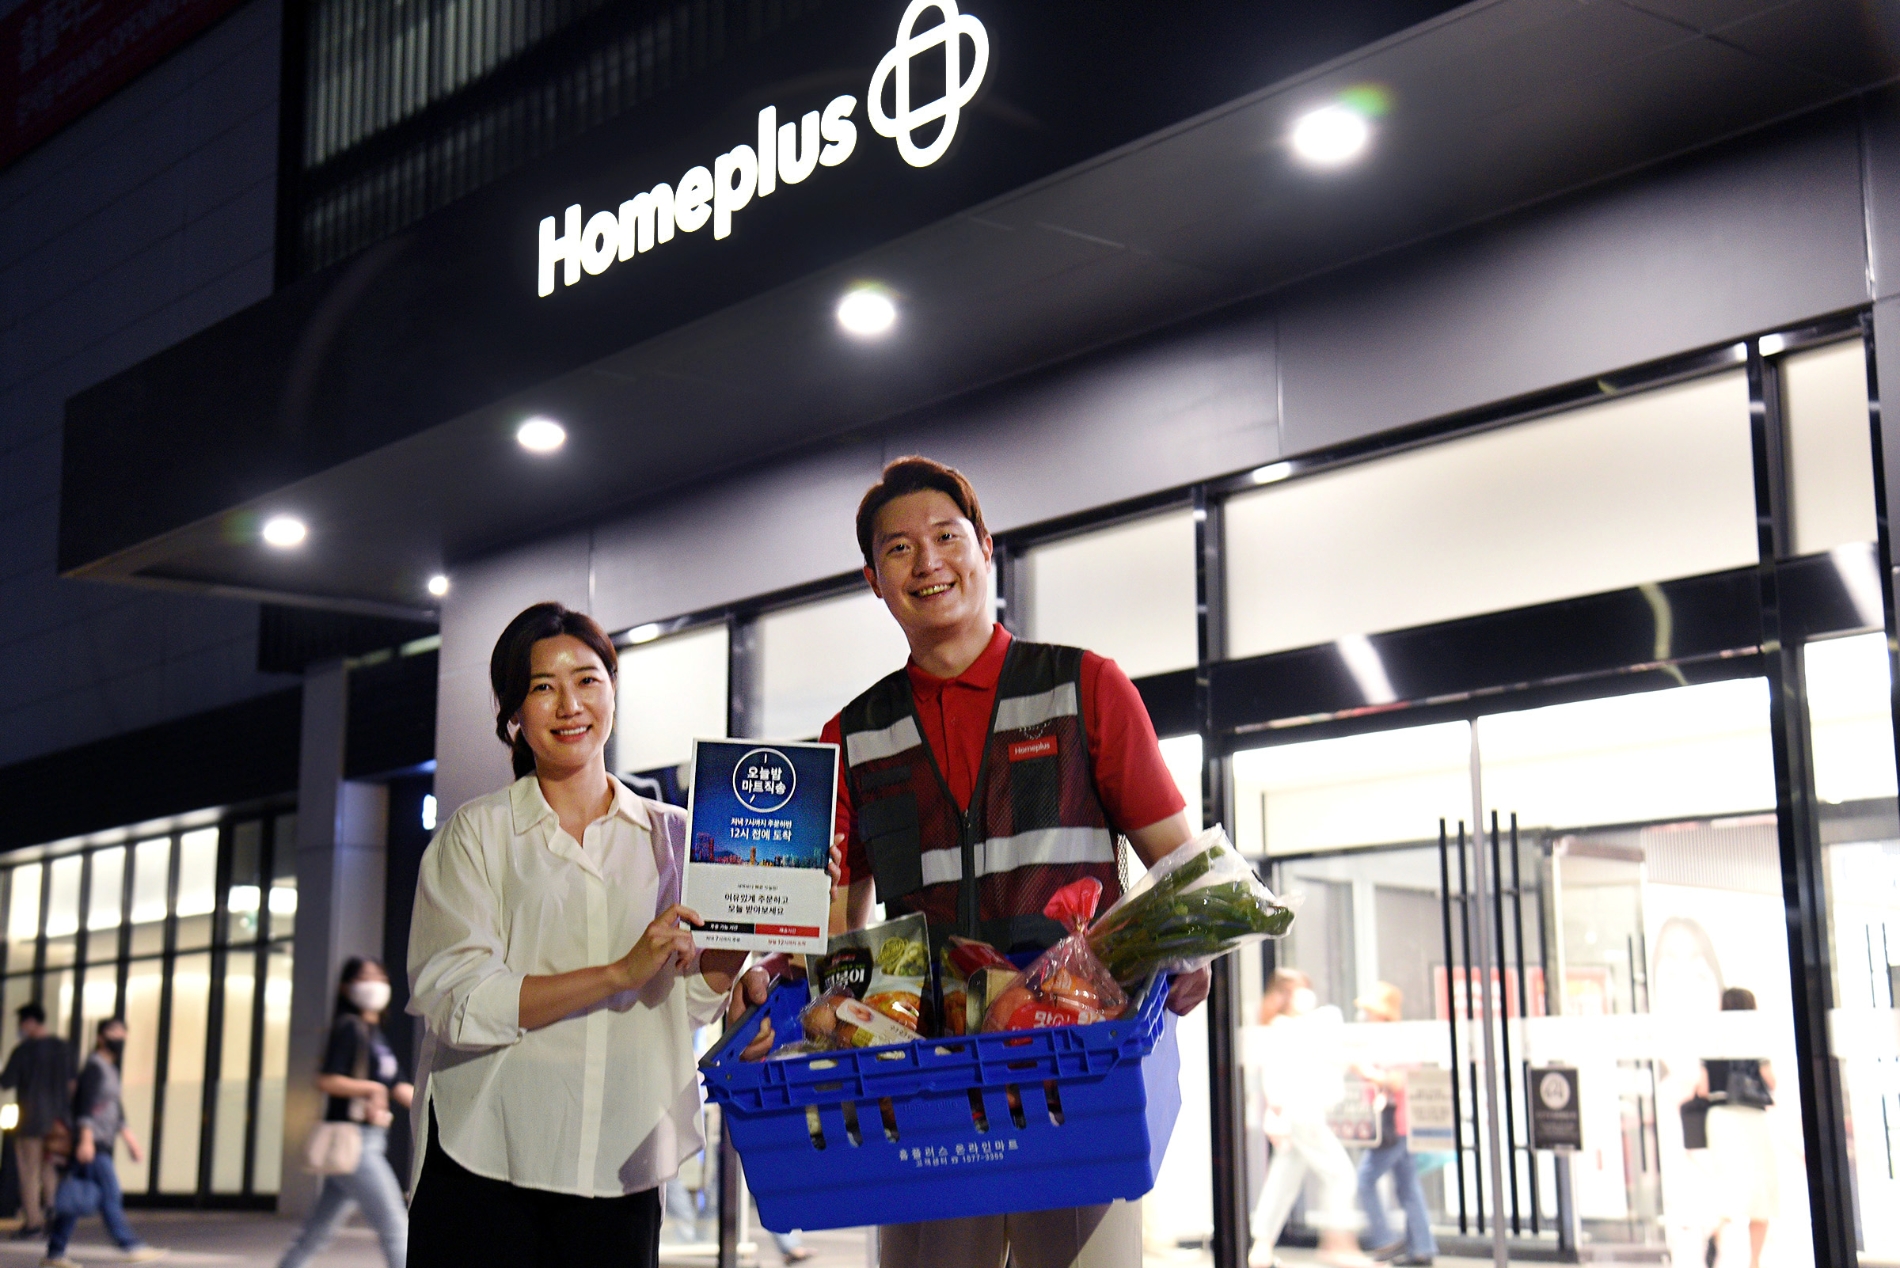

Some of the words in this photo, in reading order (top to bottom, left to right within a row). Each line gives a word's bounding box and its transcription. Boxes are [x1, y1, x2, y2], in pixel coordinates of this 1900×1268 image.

[538, 95, 857, 298] Homeplus
[1014, 742, 1050, 755] Homeplus
[747, 766, 783, 781] 오늘밤
[741, 780, 787, 795] 마트직송
[730, 817, 744, 827] 저녁
[730, 827, 749, 840] 12시
[752, 828, 771, 841] 전에
[773, 829, 792, 842] 도착
[724, 892, 755, 903] 이유있게
[758, 894, 789, 905] 주문하고
[728, 904, 743, 914] 오늘
[745, 904, 784, 916] 받아보세요
[899, 1145, 949, 1162] 홈플러스
[955, 1139, 1018, 1156] 온라인마트
